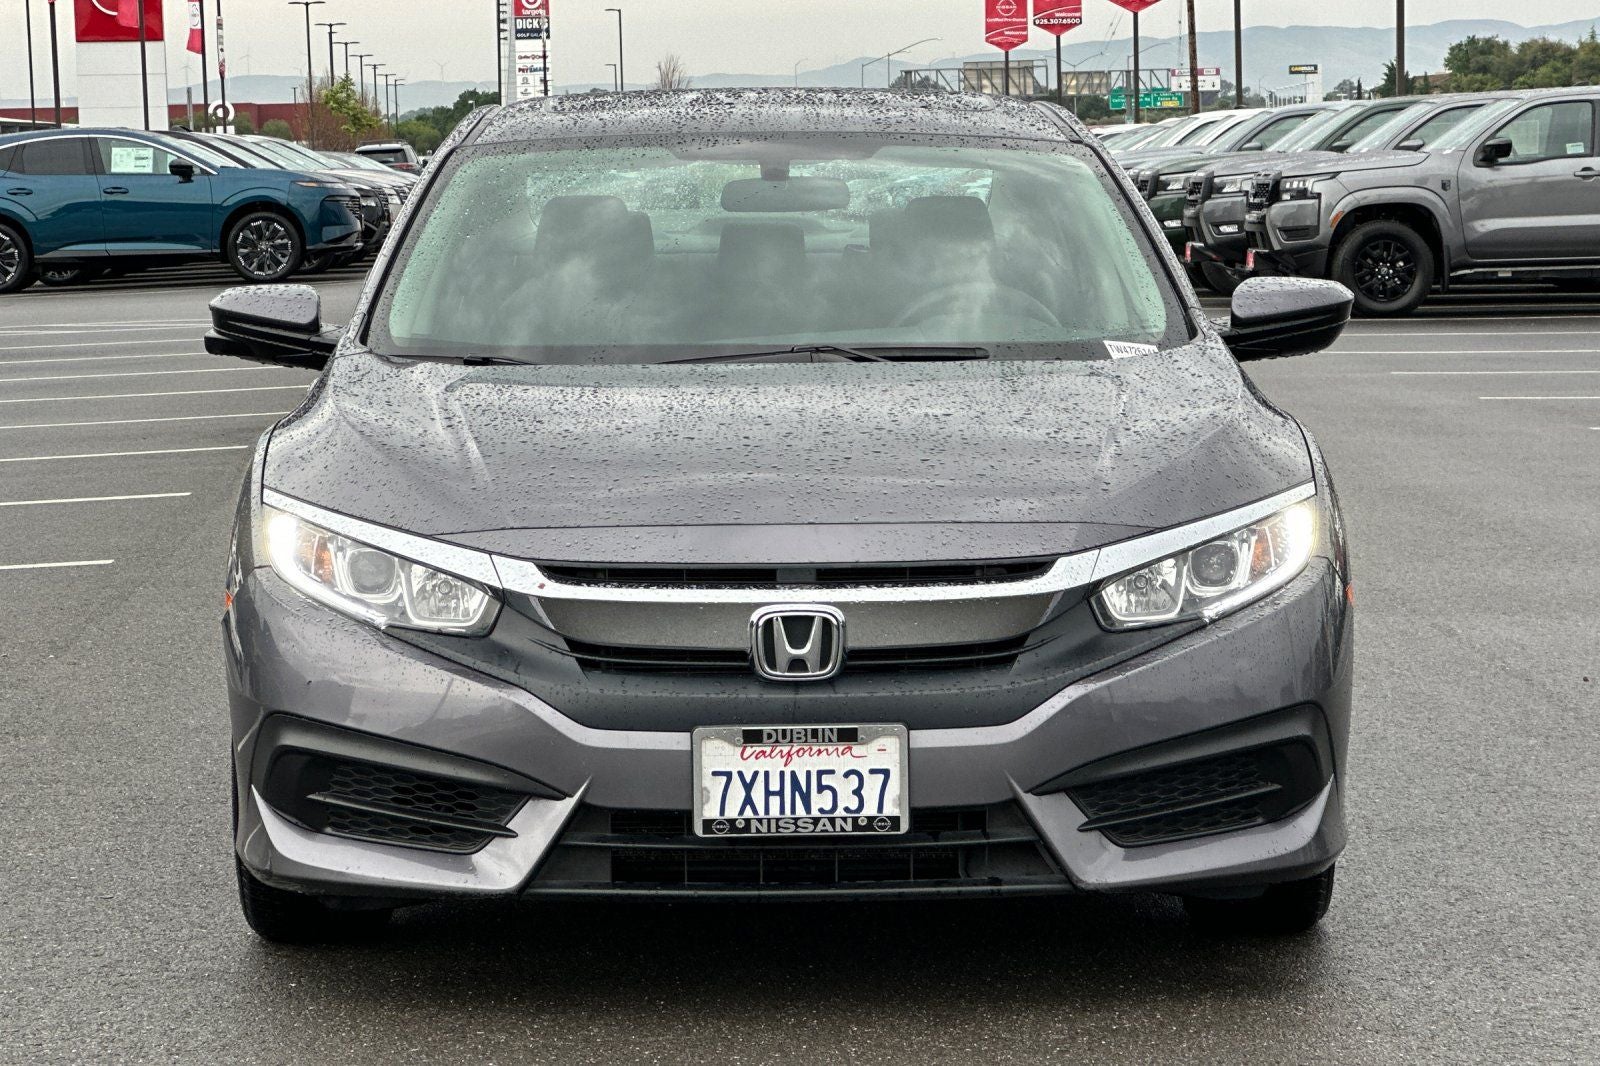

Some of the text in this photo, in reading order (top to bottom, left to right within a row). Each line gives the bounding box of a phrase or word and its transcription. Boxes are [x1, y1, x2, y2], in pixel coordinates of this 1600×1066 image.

[762, 728, 838, 743] DUBLIN
[740, 745, 867, 767] California
[711, 768, 891, 816] 7XHN537
[750, 818, 853, 833] NISSAN
